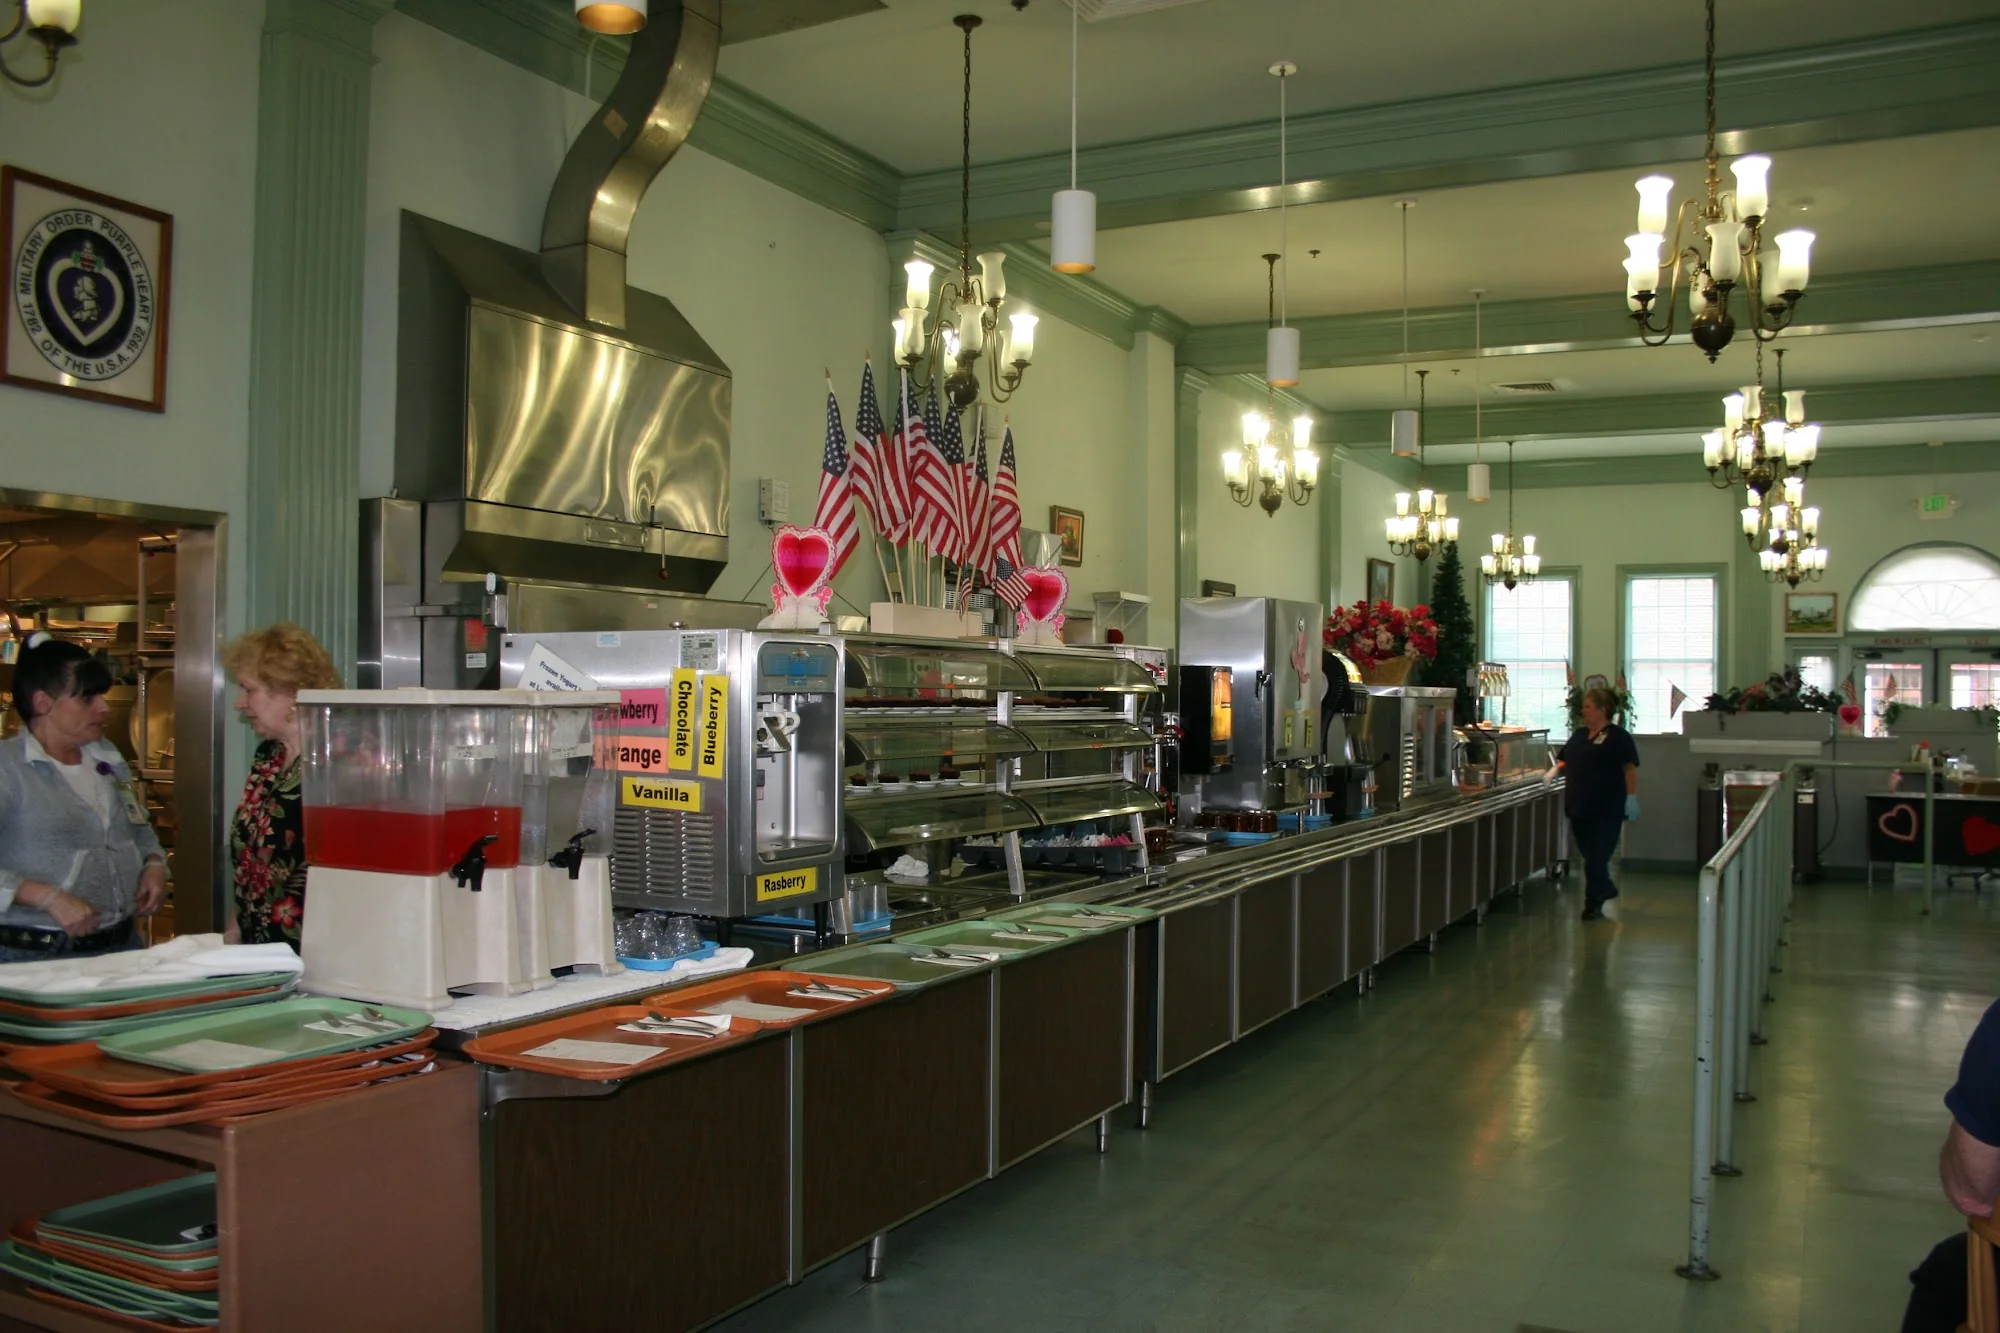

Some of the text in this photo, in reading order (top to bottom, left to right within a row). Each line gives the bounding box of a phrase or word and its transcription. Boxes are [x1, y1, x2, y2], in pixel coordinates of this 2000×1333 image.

[19, 212, 151, 323] MILITARY ORDER PURPLE HEART
[23, 303, 146, 376] 1782 OF THE U.S.A. 1932
[539, 660, 578, 692] Frozen Yogurt
[675, 680, 693, 757] Chocolate
[703, 686, 722, 766] Blueberry
[632, 784, 689, 803] Vanilla
[764, 875, 807, 894] Rasberry
